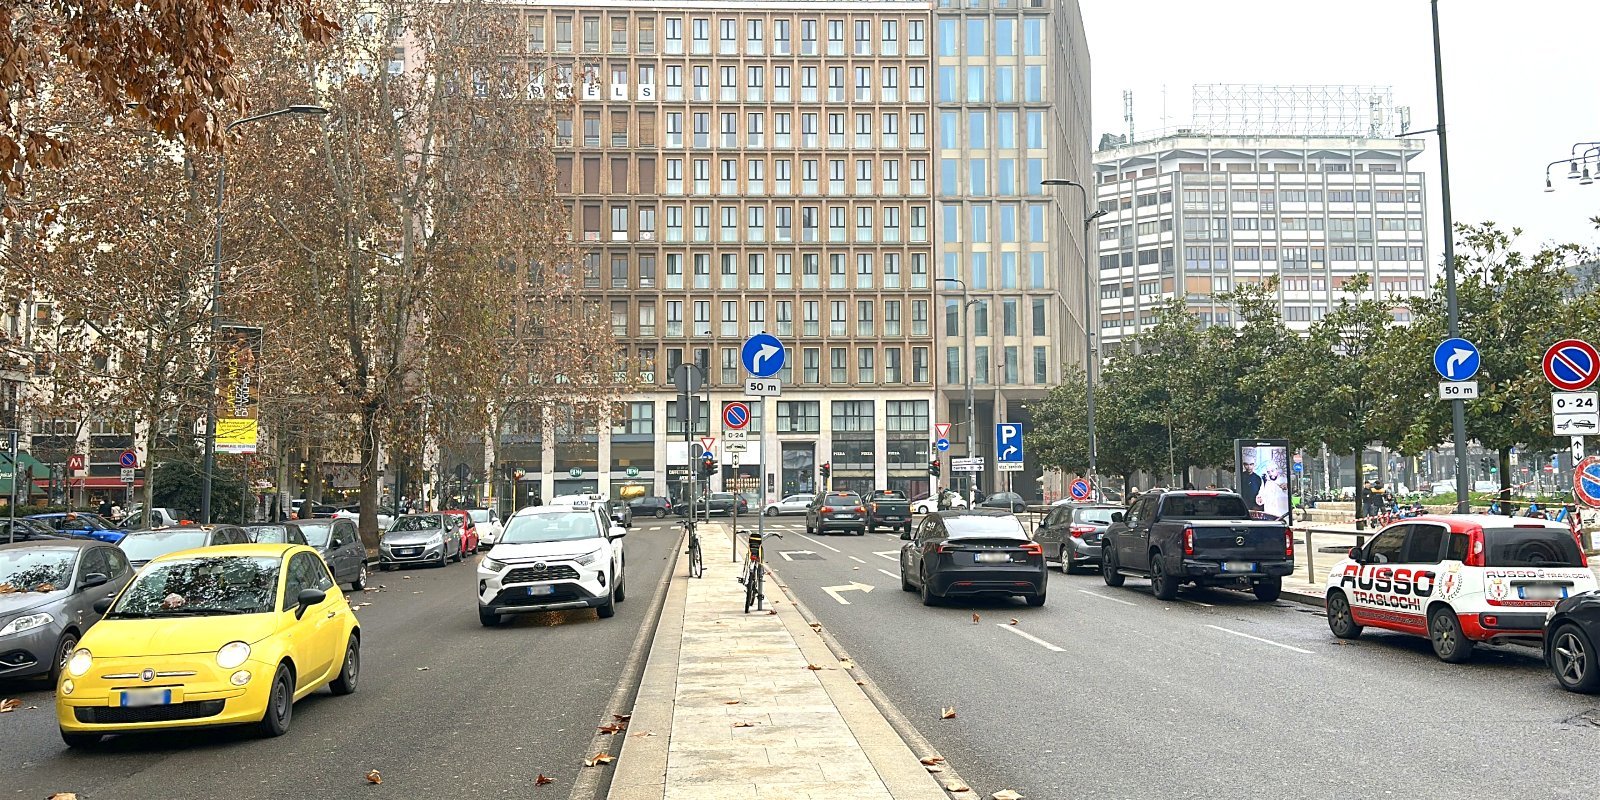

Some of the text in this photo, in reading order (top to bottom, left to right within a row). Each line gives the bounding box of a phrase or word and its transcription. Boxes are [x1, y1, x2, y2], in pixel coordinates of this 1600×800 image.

[750, 382, 764, 391] 50
[1445, 386, 1459, 394] 50
[1576, 398, 1593, 408] 24
[1001, 425, 1017, 445] P
[1486, 570, 1591, 580] RUSSO TRASLOCHI
[1341, 565, 1435, 597] RUSSO
[1353, 590, 1421, 611] TRASLOCHI
